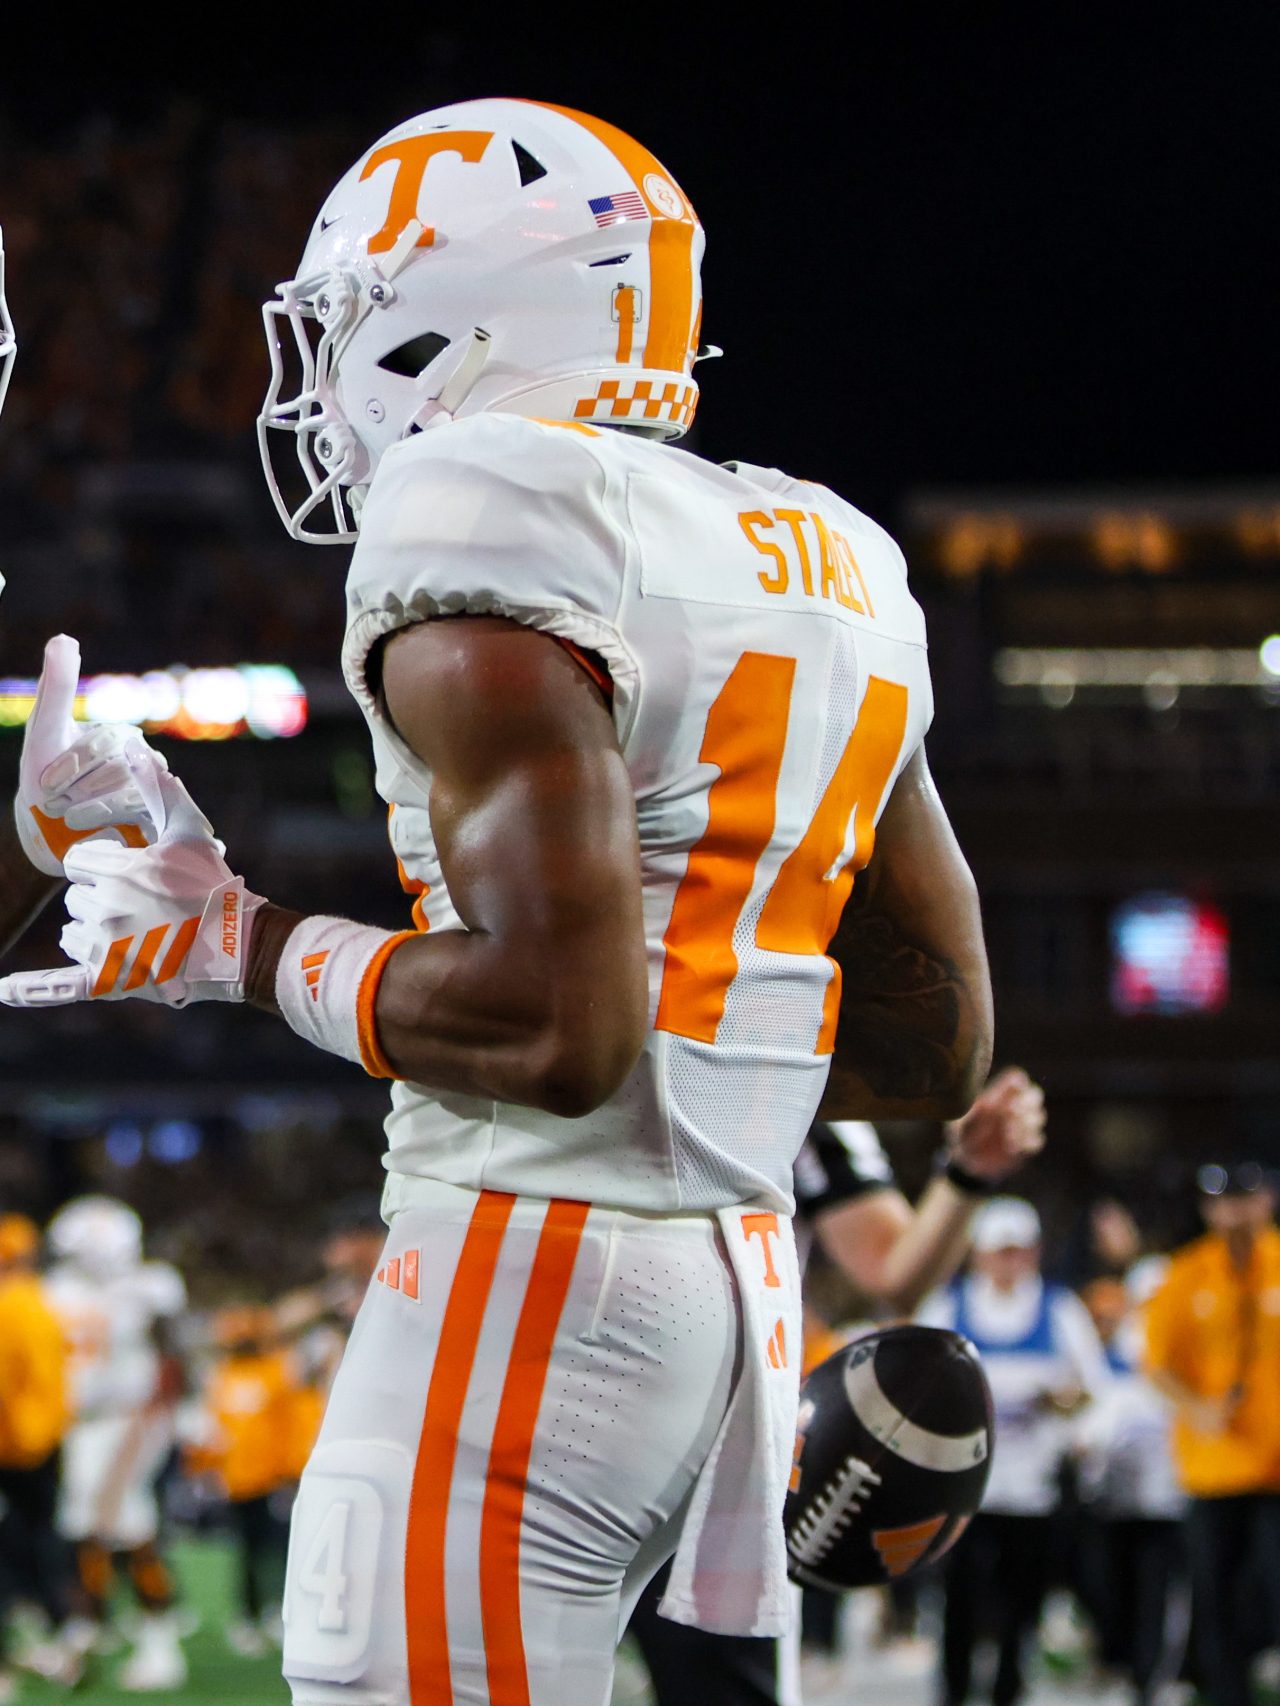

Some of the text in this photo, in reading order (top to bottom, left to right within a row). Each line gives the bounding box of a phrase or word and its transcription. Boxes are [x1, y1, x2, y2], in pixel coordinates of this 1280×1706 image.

[359, 131, 494, 255] T
[653, 651, 908, 1055] 14
[223, 891, 238, 959] ADIZERO
[741, 1213, 780, 1287] T
